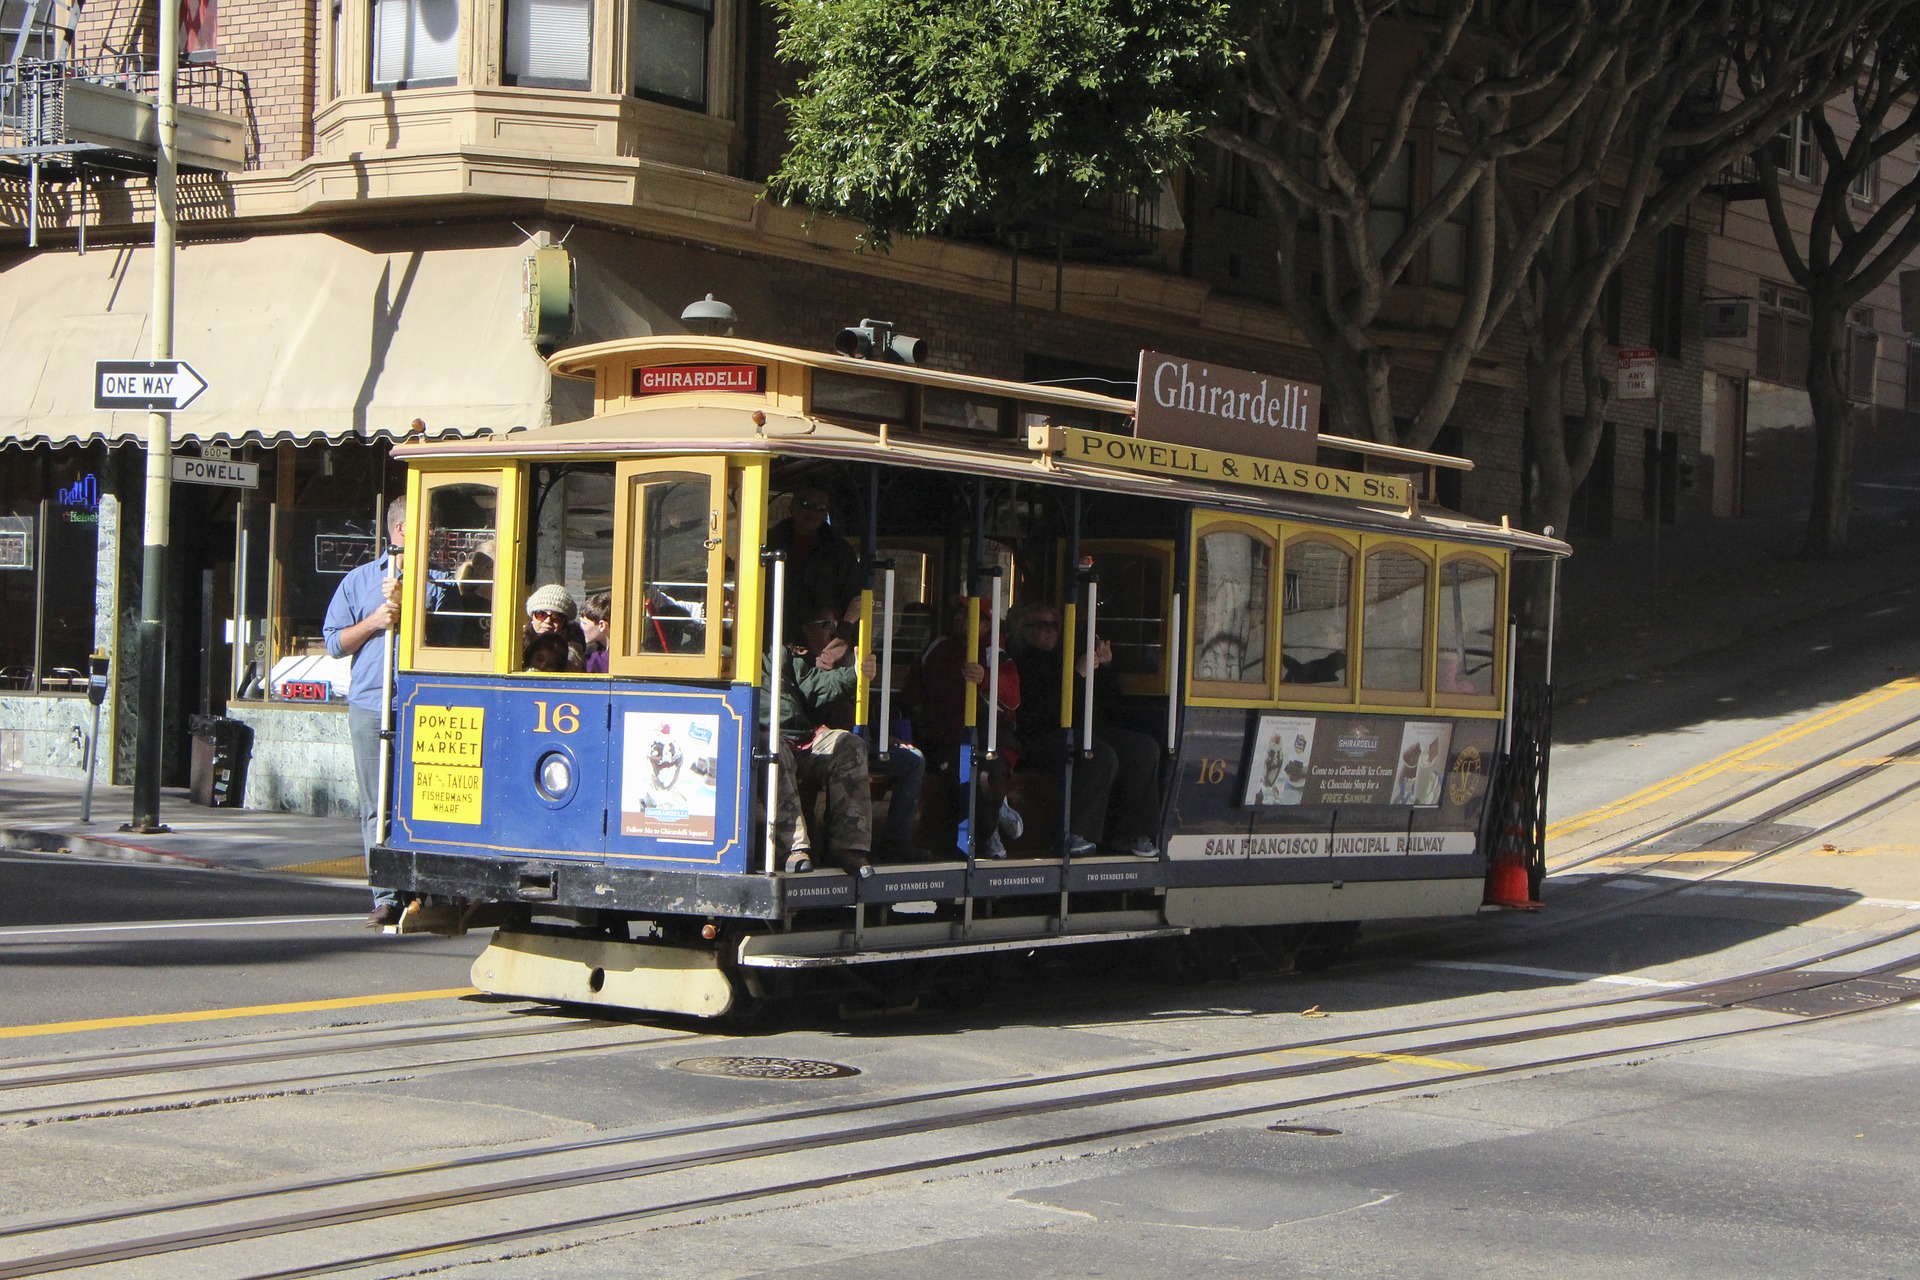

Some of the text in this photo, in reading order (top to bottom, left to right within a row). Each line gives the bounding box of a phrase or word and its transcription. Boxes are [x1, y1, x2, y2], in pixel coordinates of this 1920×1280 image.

[1619, 358, 1629, 368] NO
[643, 371, 753, 387] GHIRARDELLI
[1628, 372, 1645, 380] ANY
[106, 376, 173, 394] ONE WAY
[1626, 381, 1646, 389] TIME
[1153, 361, 1308, 432] Ghirardelli
[204, 448, 221, 457] 600
[185, 462, 245, 481] POWELL
[1082, 435, 1399, 500] POWELL & MASON Sts.
[281, 683, 325, 699] OPEN
[419, 716, 478, 730] POWELL
[532, 700, 580, 735] 16
[434, 731, 463, 741] AND
[416, 741, 478, 755] MARKET
[1196, 758, 1227, 784] 16
[1311, 765, 1327, 776] Come
[1327, 767, 1333, 775] to
[417, 772, 432, 786] BAY
[447, 774, 479, 790] TAYLOR
[422, 791, 473, 803] FISHERMANS
[1321, 793, 1343, 803] FREE
[433, 804, 460, 814] WHARF
[644, 826, 653, 834] Me
[1204, 836, 1445, 856] SAN FRANCISCO MUNICIPAL RAILWAY
[885, 881, 945, 892] TWO STANDEES ONLY
[989, 878, 1002, 886] TWO
[1030, 876, 1045, 884] ONLY
[800, 887, 830, 896] STANDEES
[832, 886, 848, 895] ONLY
